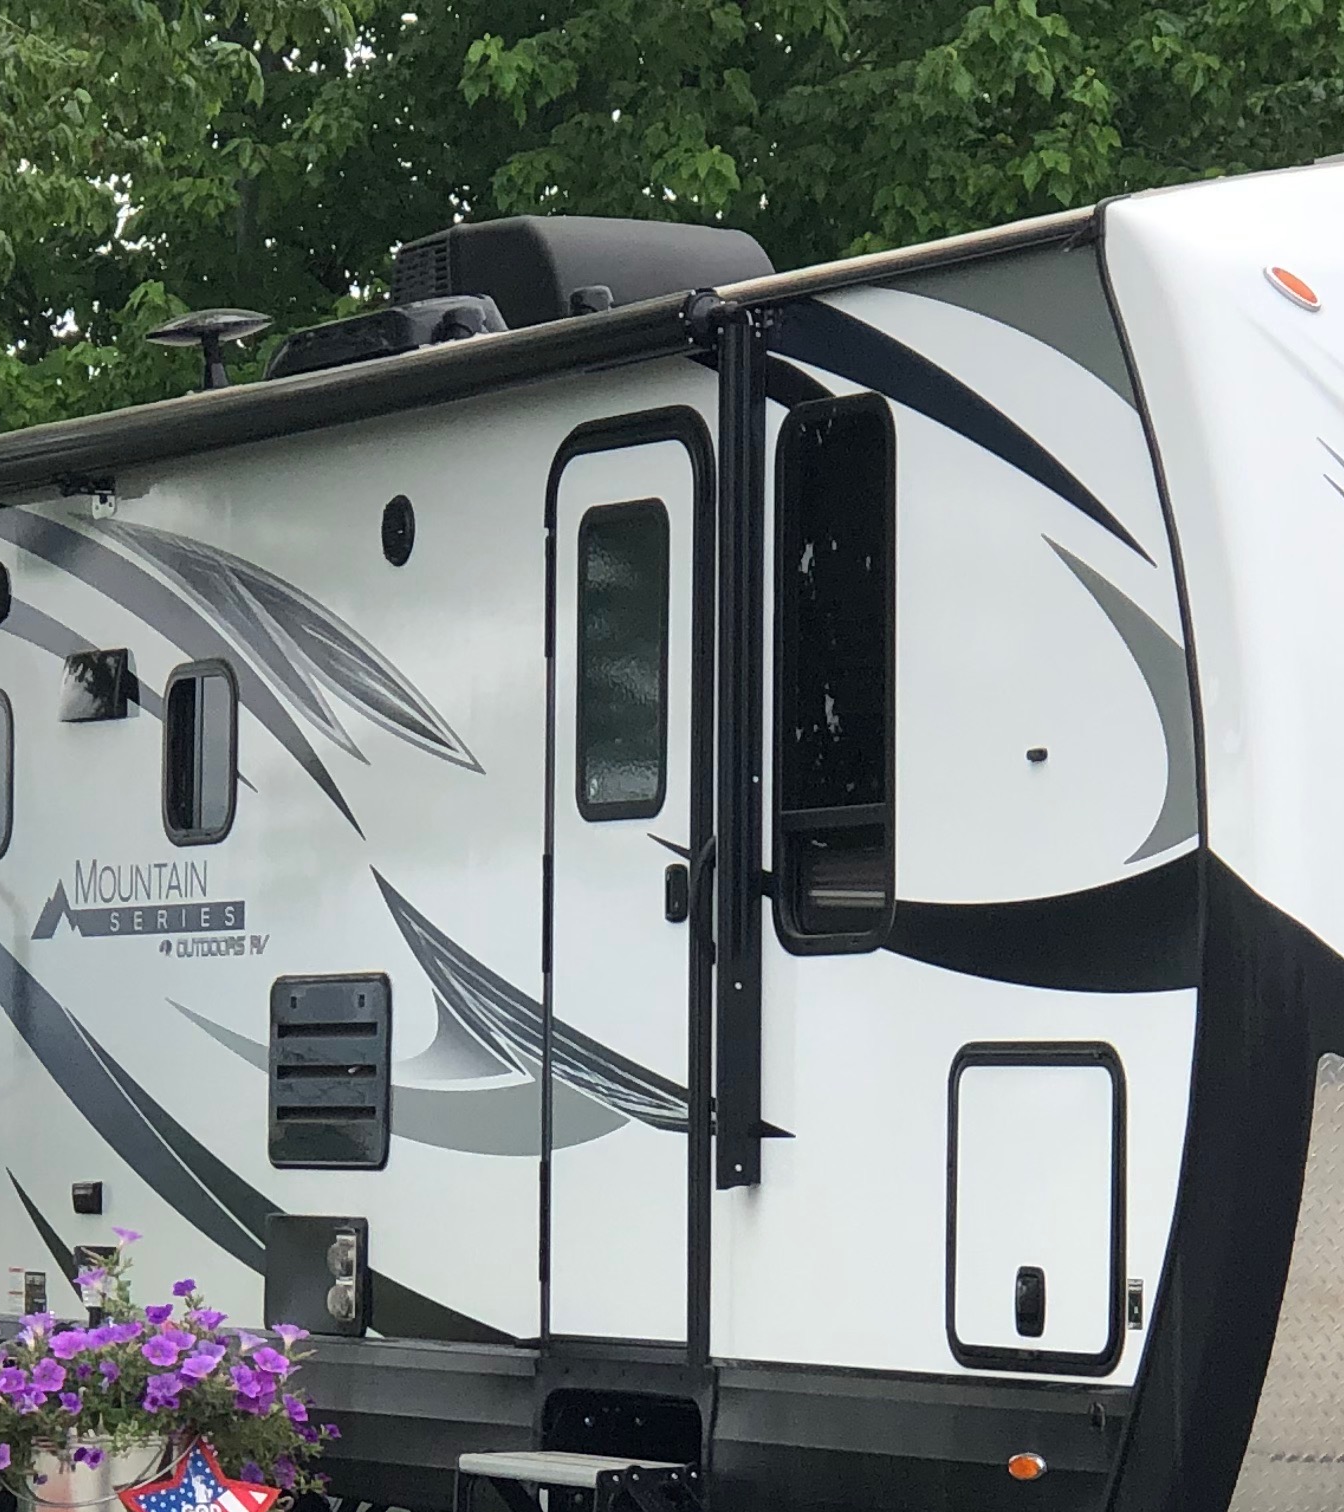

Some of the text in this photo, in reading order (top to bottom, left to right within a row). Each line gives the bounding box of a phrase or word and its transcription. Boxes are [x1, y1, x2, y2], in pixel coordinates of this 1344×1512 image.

[75, 858, 207, 904] MOUNTAIN
[109, 906, 236, 932] SERIES
[176, 934, 270, 958] OUTDOORS RV
